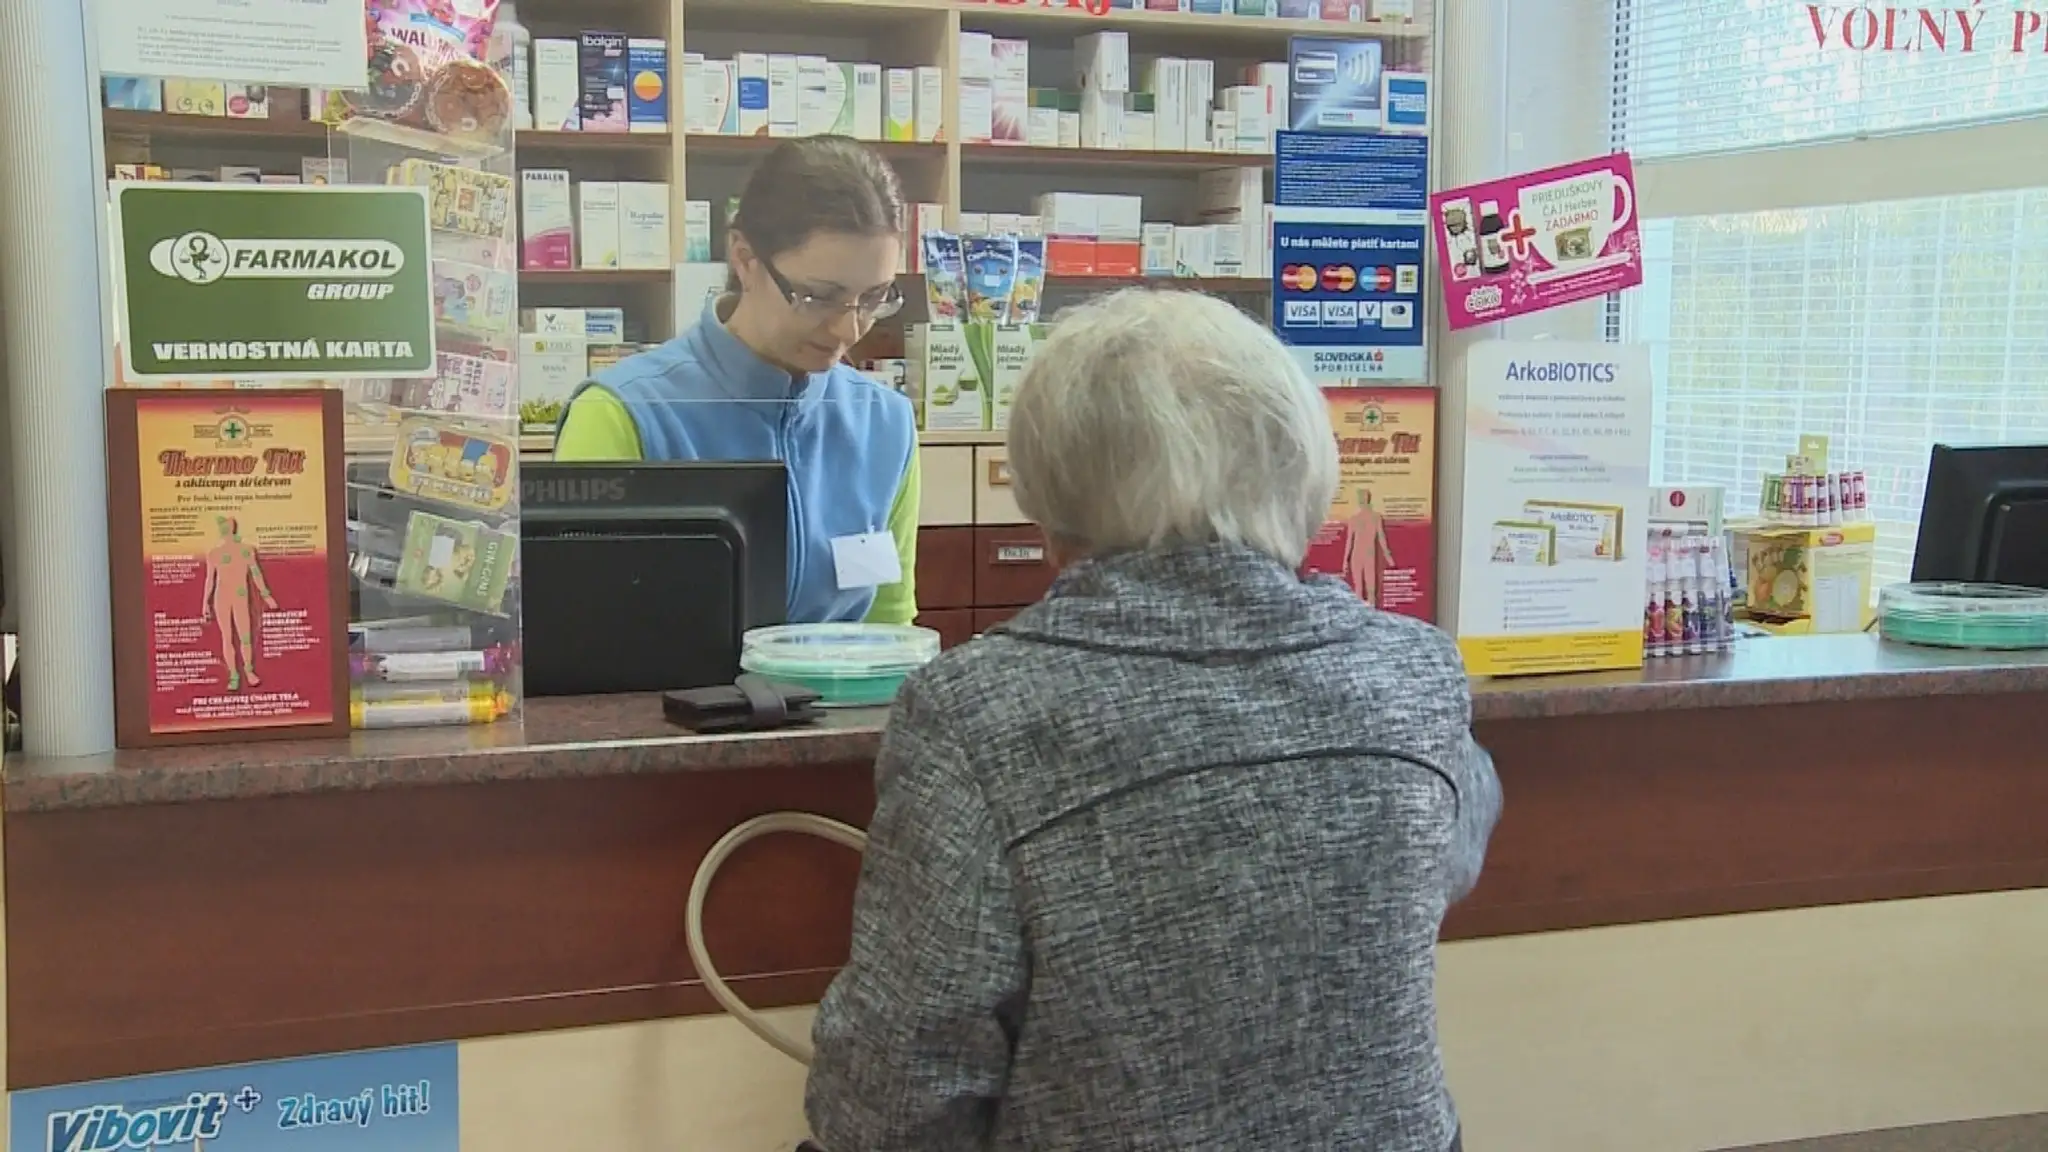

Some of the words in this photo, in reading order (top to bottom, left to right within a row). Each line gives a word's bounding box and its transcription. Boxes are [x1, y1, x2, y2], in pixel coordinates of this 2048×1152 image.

[1806, 0, 1985, 51] VOĽNÝ
[2013, 10, 2048, 51] P
[525, 172, 564, 182] PARALEN
[1544, 209, 1599, 231] ZADARMO
[1281, 236, 1289, 247] U
[1290, 235, 1310, 247] nás
[1380, 238, 1419, 249] kartami
[233, 249, 397, 270] FARMAKOL
[306, 283, 394, 300] GROUP
[1290, 305, 1317, 317] VISA
[1327, 306, 1355, 317] VISA
[151, 338, 321, 361] VERNOSTNÁ
[326, 341, 414, 359] KARTA
[158, 450, 257, 477] Thermo
[521, 477, 626, 501] PHILIPS
[277, 1088, 374, 1130] Zdravý
[381, 1080, 430, 1116] hit!
[47, 1093, 228, 1152] Vibovit
